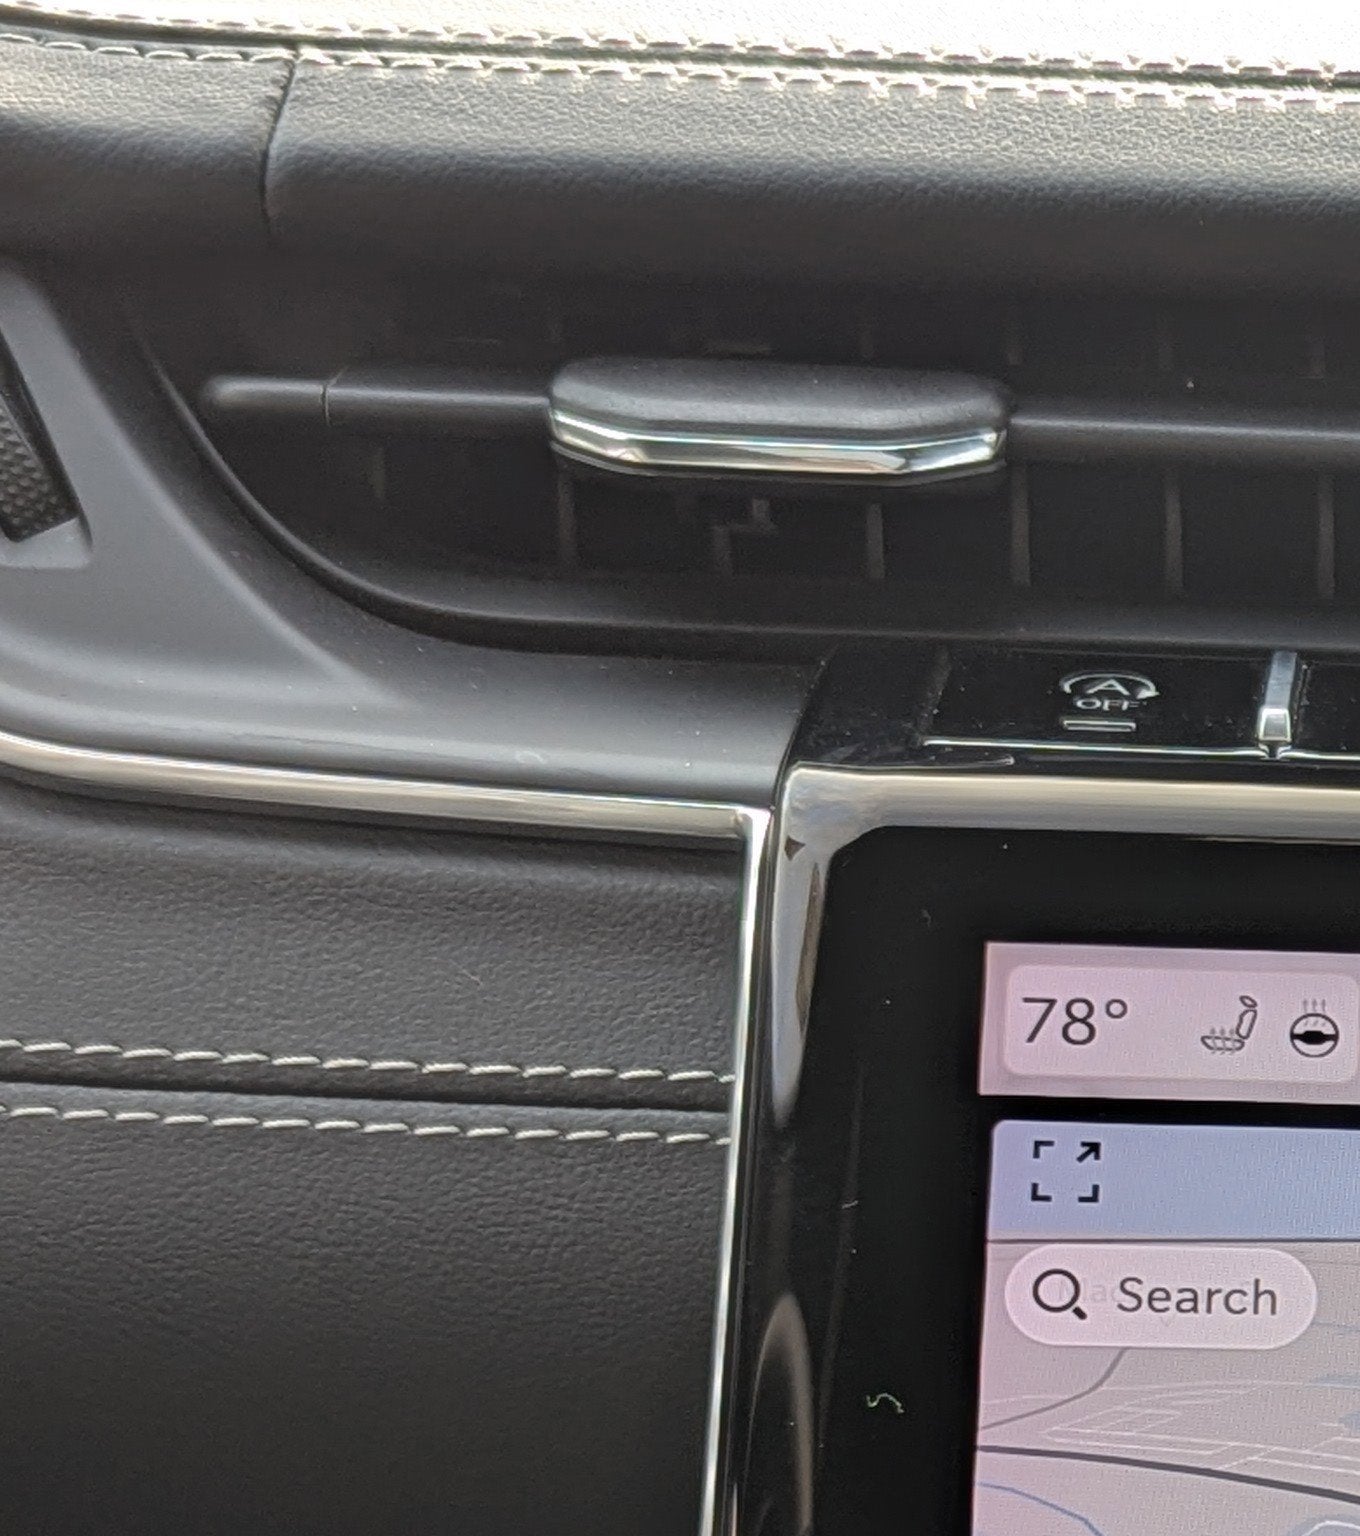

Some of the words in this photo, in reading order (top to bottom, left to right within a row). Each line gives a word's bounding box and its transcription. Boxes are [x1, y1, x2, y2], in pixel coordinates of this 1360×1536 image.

[1076, 699, 1139, 711] OFF
[1022, 997, 1128, 1046] 78°
[1117, 1277, 1278, 1316] Search
